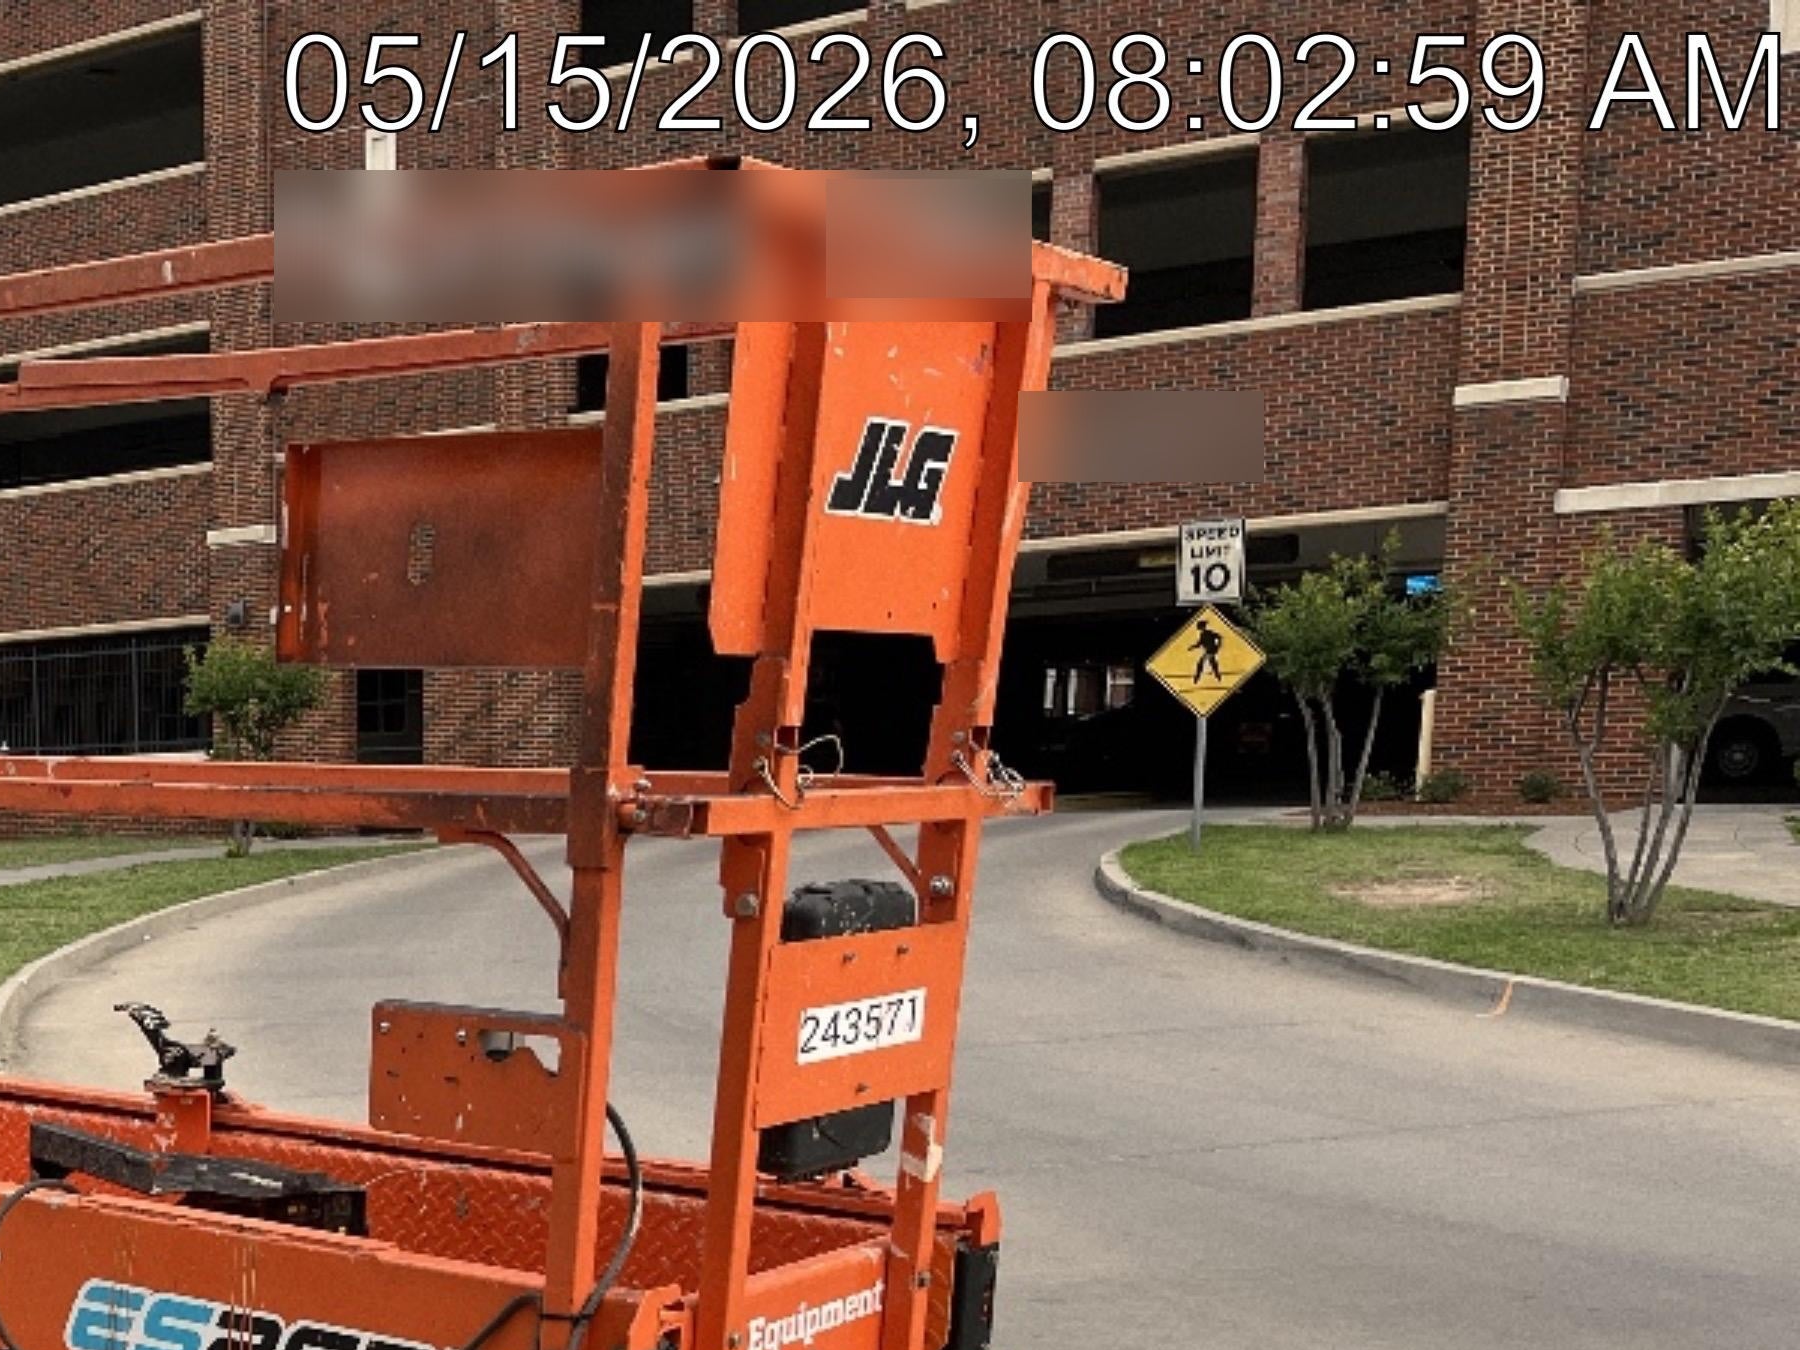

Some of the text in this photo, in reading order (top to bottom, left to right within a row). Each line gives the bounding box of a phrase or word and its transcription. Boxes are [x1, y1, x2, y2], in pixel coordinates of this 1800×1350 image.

[826, 416, 958, 524] JLG
[1185, 527, 1240, 541] SPEED
[1191, 545, 1231, 559] LIMIT
[1191, 563, 1230, 594] 10
[800, 997, 918, 1053] 243571
